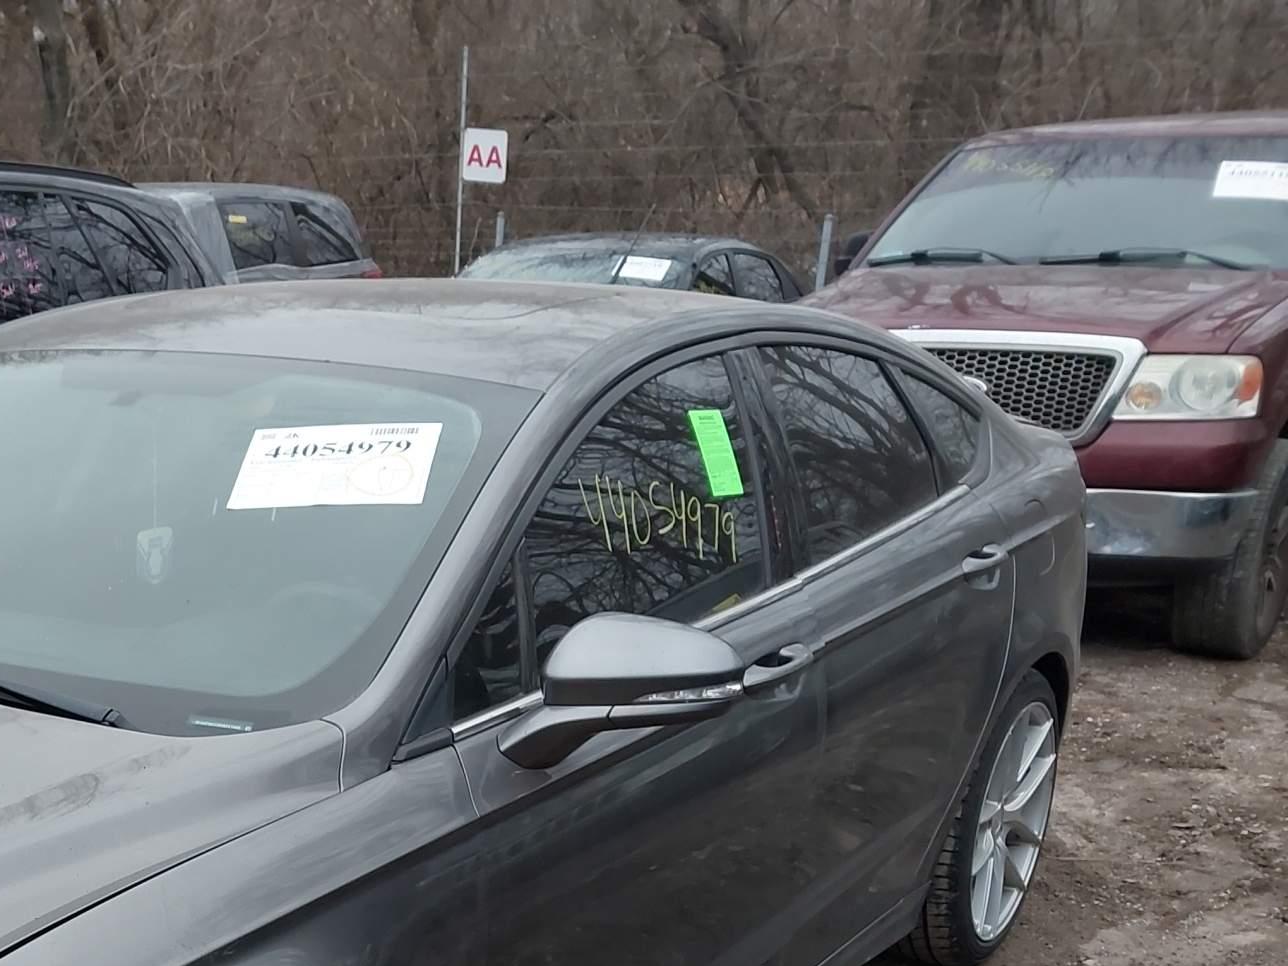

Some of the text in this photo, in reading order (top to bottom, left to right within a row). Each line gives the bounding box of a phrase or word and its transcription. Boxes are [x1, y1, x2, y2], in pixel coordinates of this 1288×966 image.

[467, 144, 502, 169] AA
[264, 439, 413, 458] 44054979
[577, 473, 738, 563] 44054979
